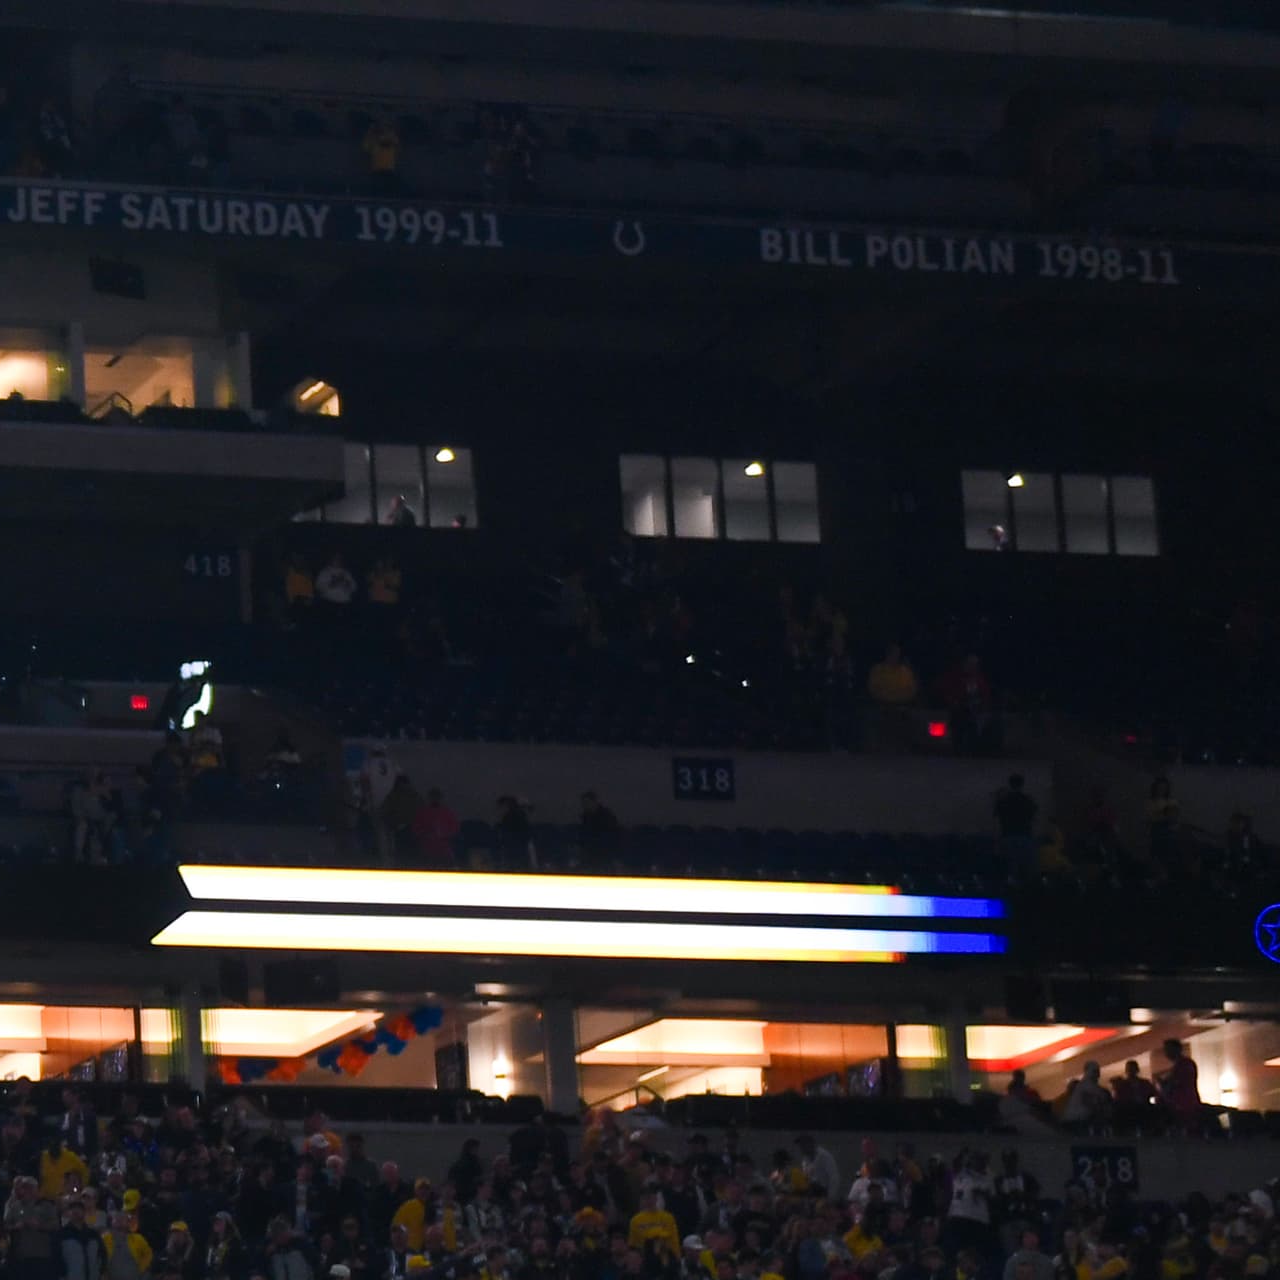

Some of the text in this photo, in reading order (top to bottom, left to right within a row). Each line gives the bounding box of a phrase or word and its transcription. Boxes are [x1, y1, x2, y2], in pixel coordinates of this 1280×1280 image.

[7, 186, 504, 248] JEFF SATURDAY 1999-11
[760, 228, 1181, 286] BILL POLIAN 1998-11
[184, 554, 232, 578] 418
[677, 767, 730, 792] 318
